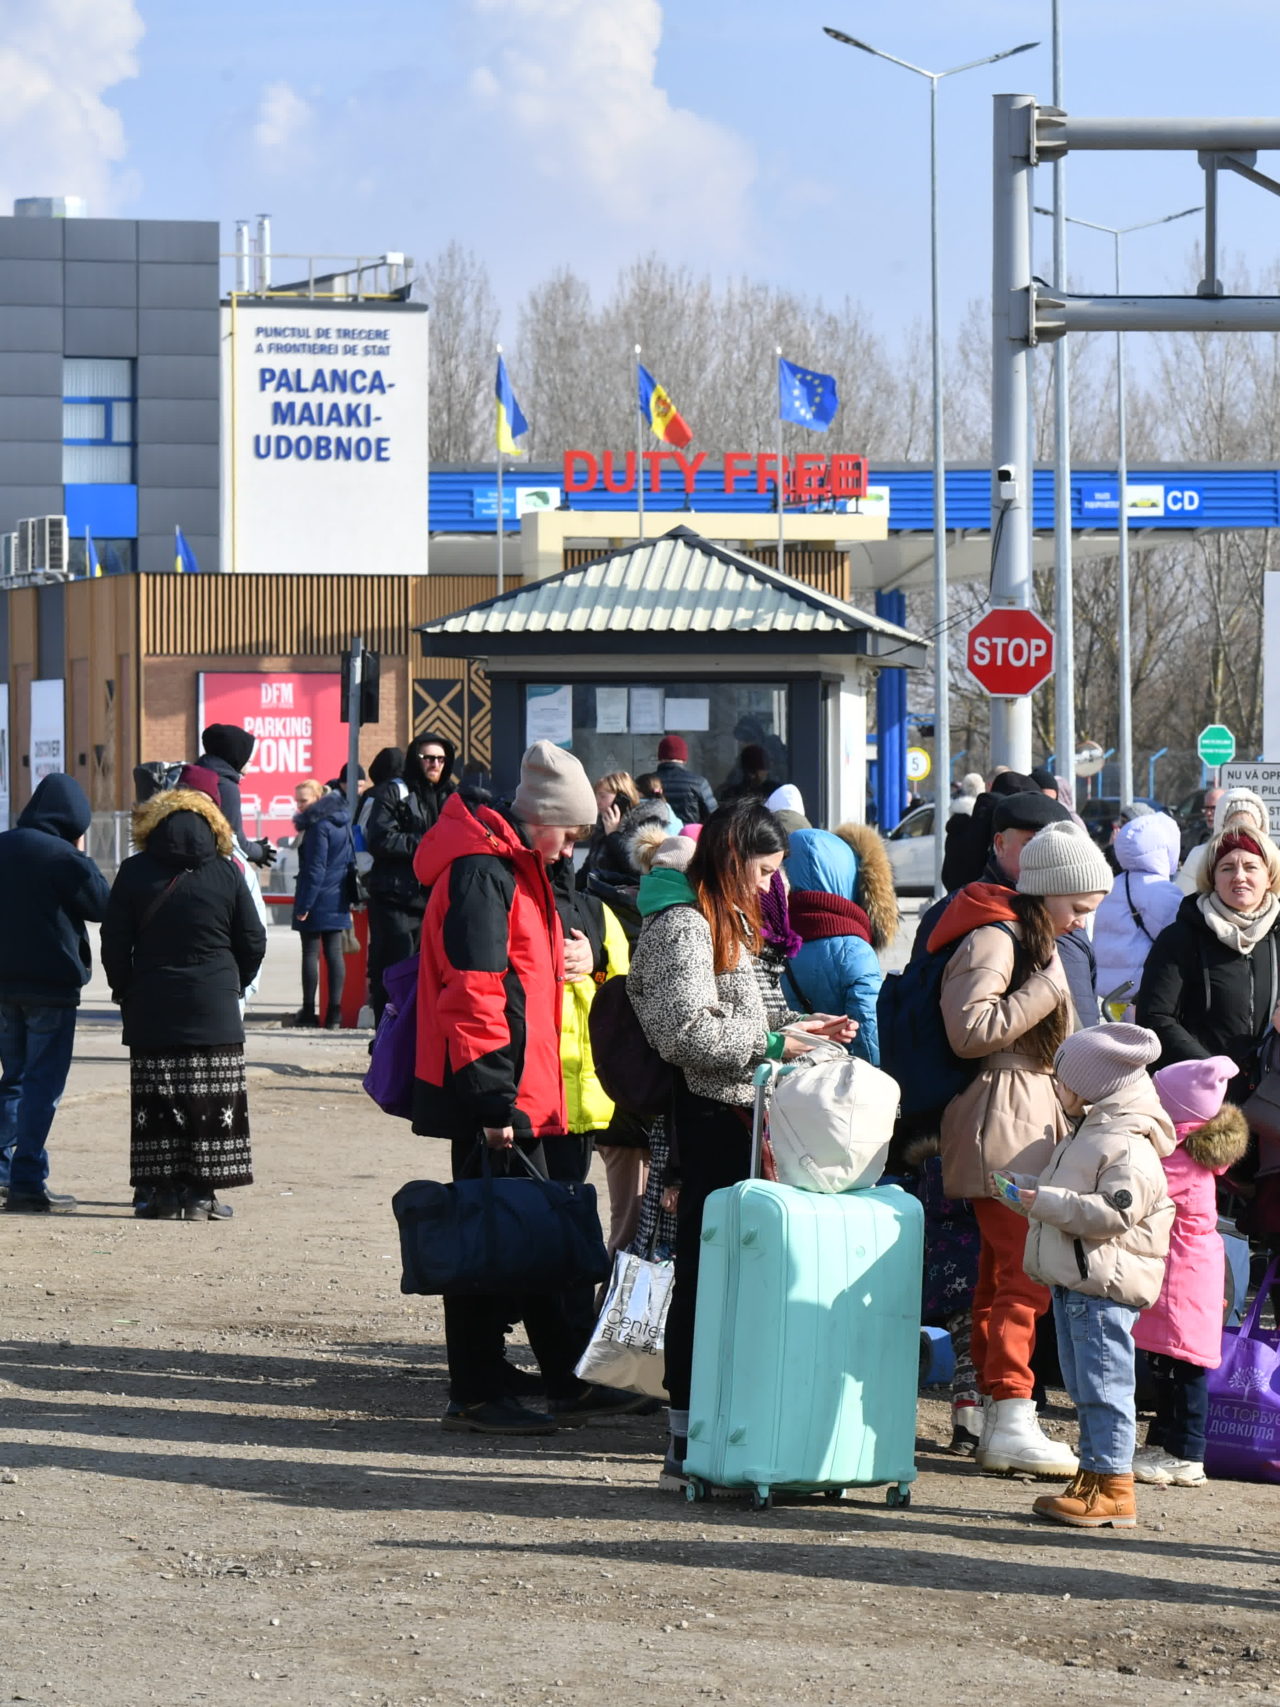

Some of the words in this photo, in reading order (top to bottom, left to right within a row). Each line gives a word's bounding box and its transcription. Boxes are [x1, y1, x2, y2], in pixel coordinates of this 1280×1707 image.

[255, 327, 311, 338] PUNCTUL
[315, 328, 332, 339] DE
[335, 328, 390, 340] TRECERE
[254, 343, 264, 353] A
[267, 343, 339, 355] FRONTIEREI
[342, 345, 358, 356] DE
[362, 345, 391, 356] STAT
[259, 368, 395, 394] PALANCA-
[272, 401, 382, 427] MAIAKI-
[254, 434, 391, 462] UDOBNOE
[563, 451, 706, 493] DUTY
[723, 453, 865, 497] FREE
[1166, 490, 1200, 511] CD
[973, 636, 1047, 667] STOP
[261, 682, 293, 703] DFM
[244, 716, 312, 738] PARKING
[912, 755, 919, 769] 5
[1227, 770, 1241, 780] NU
[1208, 1419, 1275, 1441] ДОВКІЛЛЯ
